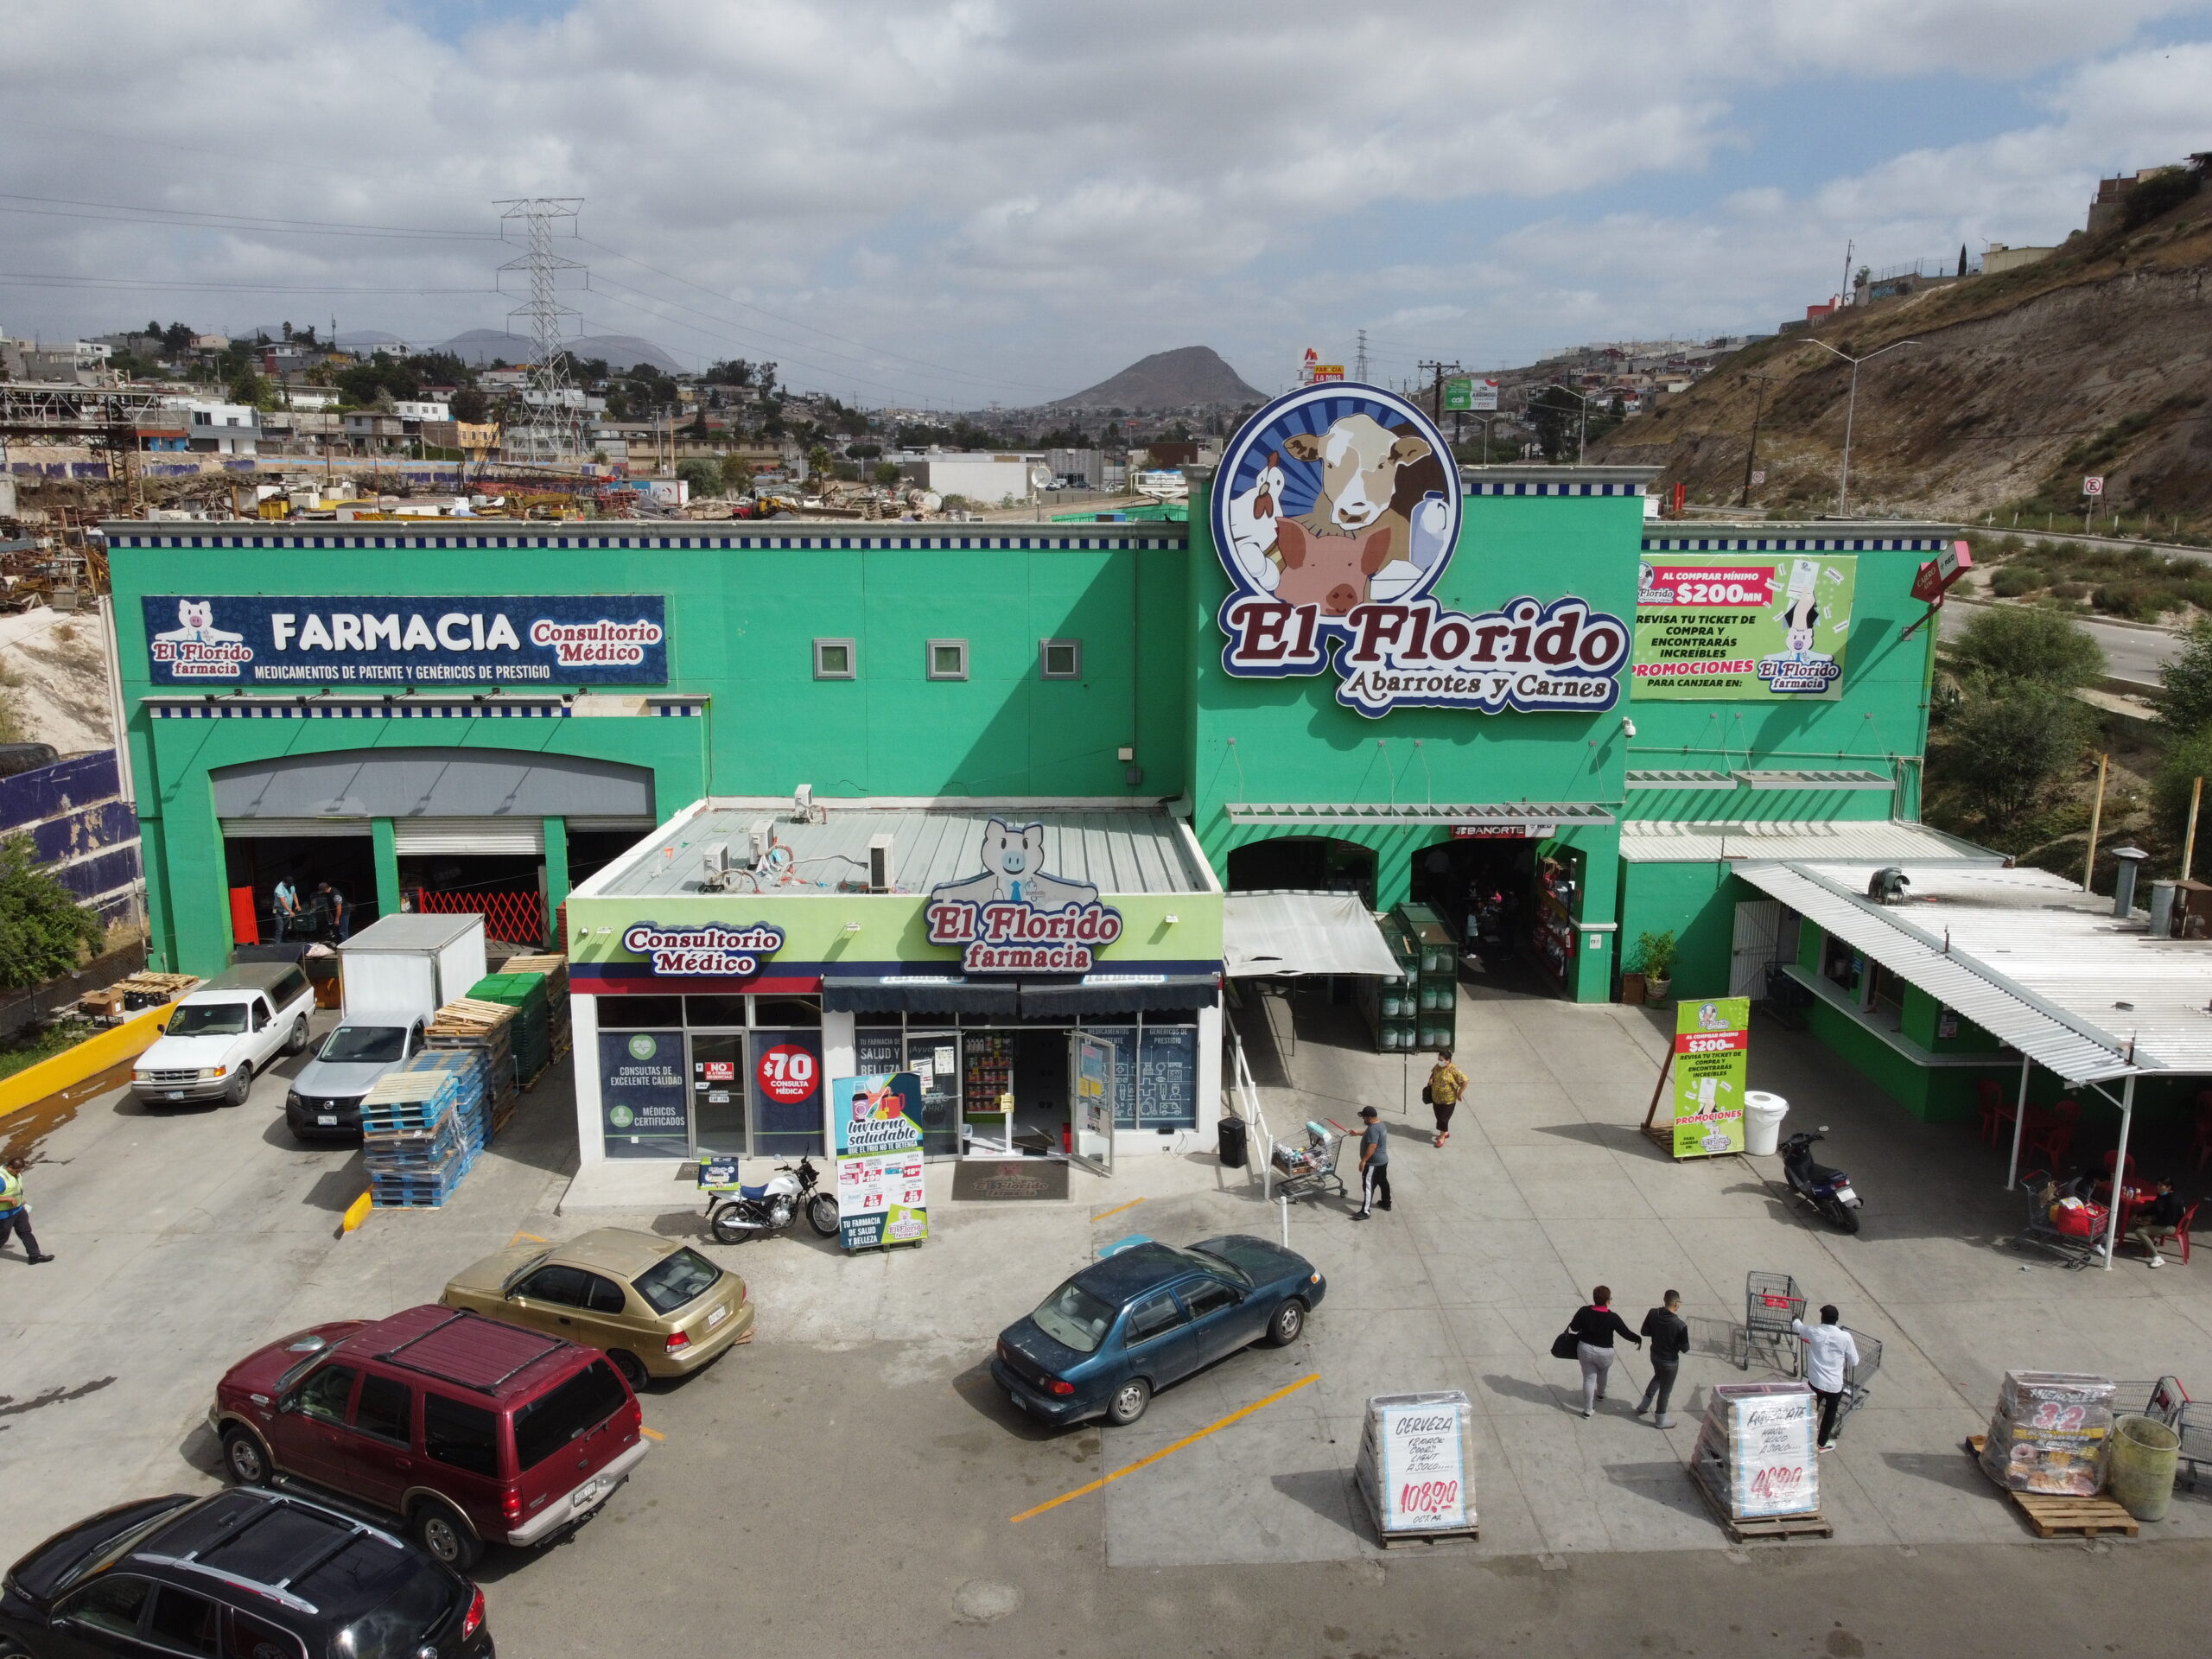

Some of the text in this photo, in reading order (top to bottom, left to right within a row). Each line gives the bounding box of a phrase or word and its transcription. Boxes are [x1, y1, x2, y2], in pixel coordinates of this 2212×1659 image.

[1723, 571, 1758, 581] MÍNIMO
[1917, 567, 1936, 588] CAJERO
[1637, 615, 1756, 625] REVISA TU TICKET DE
[271, 613, 520, 652] FARMACIA
[534, 623, 658, 642] Consultorio
[1231, 603, 1621, 665] El Florido
[1666, 626, 1726, 636] COMPRA Y
[1651, 637, 1738, 647] ENCONTRARÁS
[154, 642, 252, 661] El Florido
[561, 643, 640, 662] Médico
[1660, 648, 1727, 658] INCREÍBLES
[175, 662, 238, 675] farmacia
[255, 664, 550, 679] MEDICAMENTOS DE PATENTE Y GENÉRICOS DE PRESTIGIO
[1759, 662, 1837, 677] El Florido
[1349, 671, 1606, 702] Abarrotes y Carnes
[1772, 677, 1823, 689] farmacia
[1467, 826, 1524, 835] BANORTE
[929, 906, 1119, 940] El Florido
[628, 927, 778, 949] Consultorio
[657, 951, 753, 973] Médico
[968, 946, 1089, 969] farmacia
[861, 1047, 900, 1059] SALUD Y
[620, 1066, 672, 1076] CONSULTAS DE
[764, 1053, 812, 1081] $70
[861, 1064, 900, 1076] BELLEZA
[610, 1076, 683, 1086] EXCELENTE CALIDAD
[776, 1086, 804, 1095] MÉDICA
[642, 1106, 676, 1116] MÉDICOS
[1675, 1109, 1742, 1125] PROMOCIONES
[634, 1116, 685, 1127] CERTIFICADOS
[849, 1119, 906, 1134] Invierno
[849, 1127, 916, 1146] saludable
[995, 1181, 1049, 1190] Florido
[852, 1217, 880, 1227] FARMACIA
[899, 1224, 925, 1232] Florido
[859, 1226, 876, 1236] SALUD
[848, 1236, 877, 1246] Y BELLEZA
[1395, 1415, 1453, 1435] CERVEZA
[1411, 1453, 1440, 1463] LIGHT
